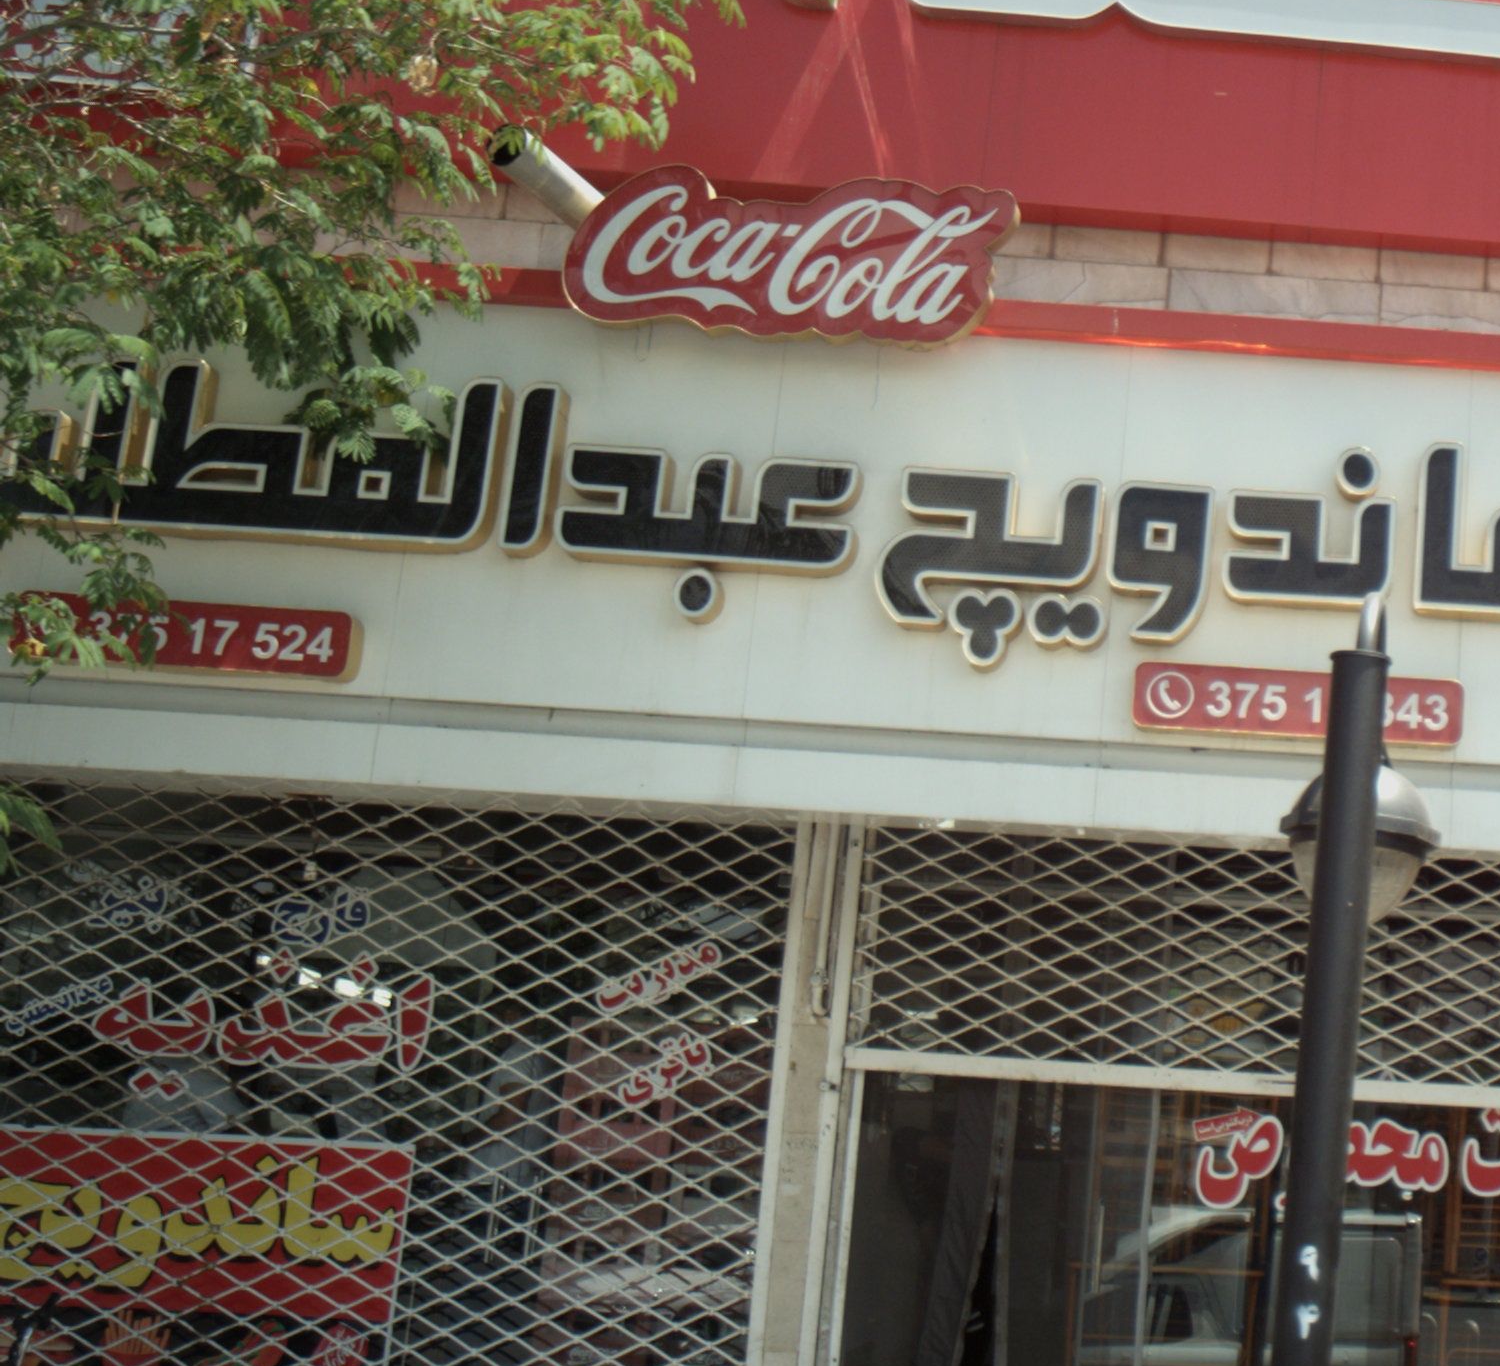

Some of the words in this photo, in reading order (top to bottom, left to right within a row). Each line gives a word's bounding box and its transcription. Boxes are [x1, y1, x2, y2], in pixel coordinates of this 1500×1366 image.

[582, 184, 999, 325] Coca-Cola
[190, 616, 241, 657] 17
[250, 620, 335, 664] 524
[1206, 679, 1288, 723] 375
[596, 941, 723, 1012] مدیریت
[93, 947, 436, 1104] اغذیه
[618, 1032, 717, 1107] باقری
